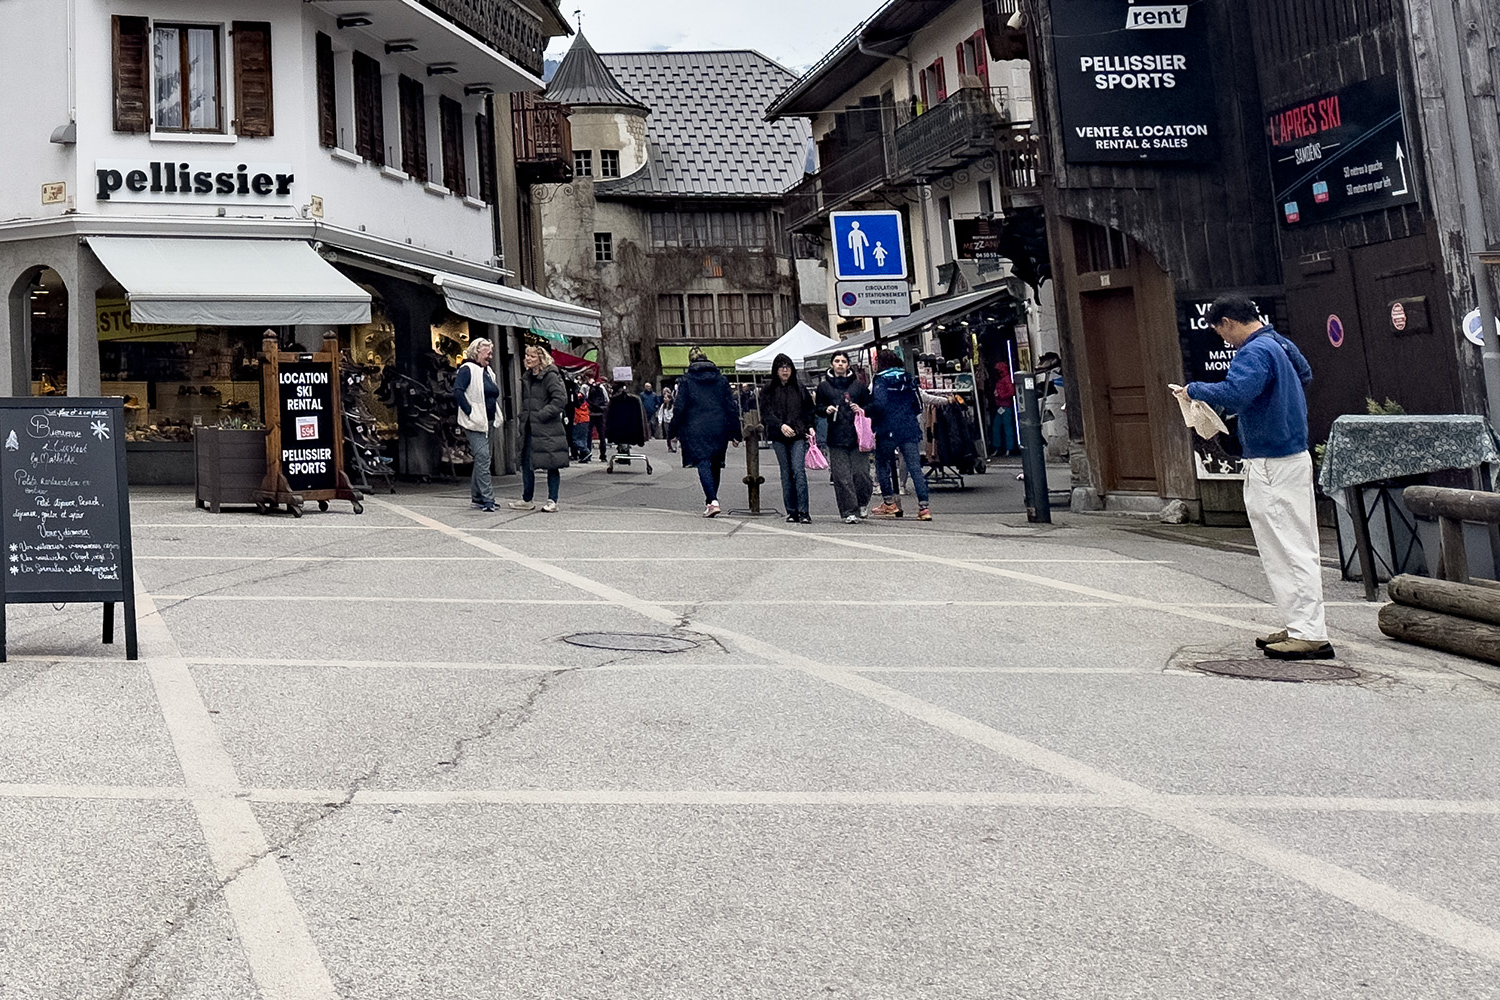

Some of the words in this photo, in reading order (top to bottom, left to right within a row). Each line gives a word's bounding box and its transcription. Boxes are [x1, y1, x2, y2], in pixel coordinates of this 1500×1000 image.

[1133, 8, 1182, 25] rent
[1080, 55, 1187, 72] PELLISSIER
[1094, 73, 1176, 89] SPORTS
[1270, 103, 1317, 146] L'APRES
[1318, 95, 1342, 131] SKI
[1075, 126, 1120, 138] VENTE
[1122, 126, 1133, 137] &
[1135, 125, 1208, 137] LOCATION
[1095, 139, 1140, 150] RENTAL
[1141, 139, 1151, 149] &
[1153, 138, 1188, 148] SALES
[96, 161, 294, 200] pellissier
[1205, 362, 1231, 371] MON
[279, 372, 328, 384] LOCATION
[296, 385, 312, 397] SKI
[287, 398, 323, 410] RENTAL
[282, 448, 331, 461] PELLISSIER
[288, 462, 326, 475] SPORTS
